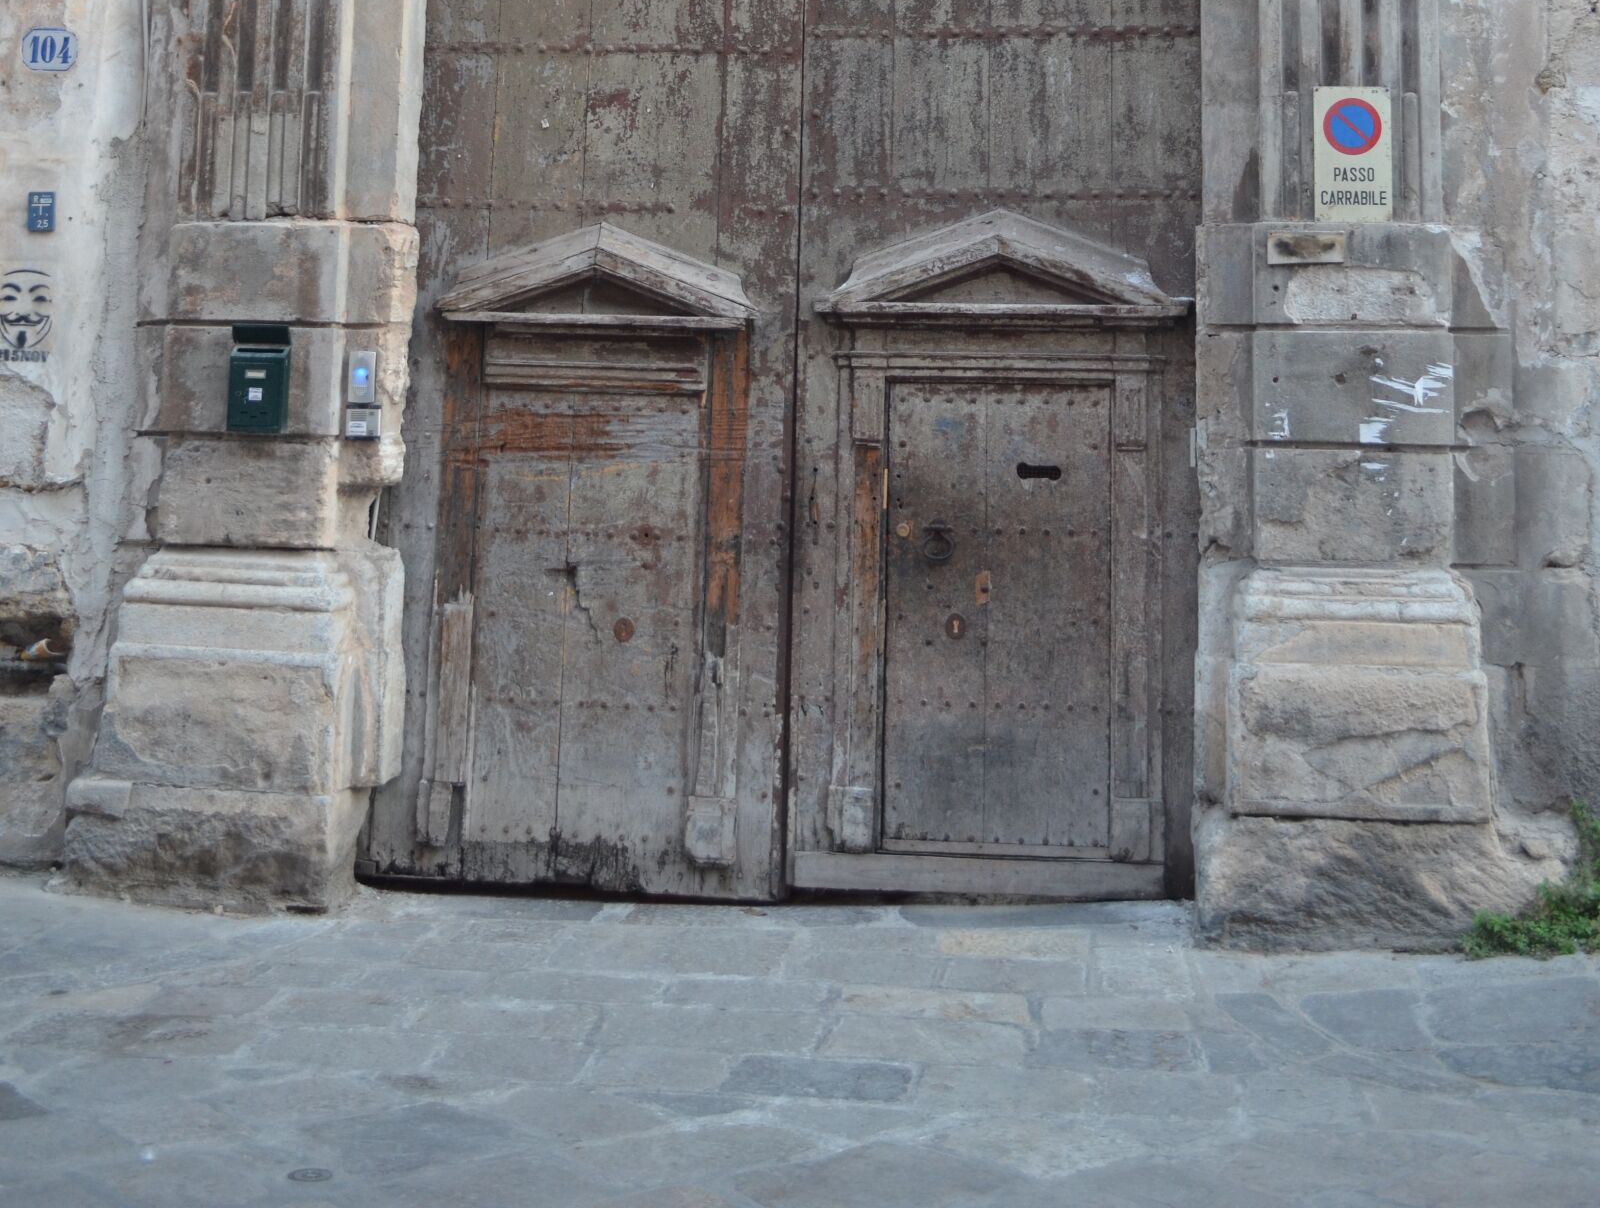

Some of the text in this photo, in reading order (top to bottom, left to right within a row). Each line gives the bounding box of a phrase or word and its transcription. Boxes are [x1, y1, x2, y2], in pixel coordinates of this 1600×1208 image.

[30, 35, 72, 64] 104
[1333, 167, 1375, 182] PASSO
[1320, 190, 1388, 206] CARRABILE
